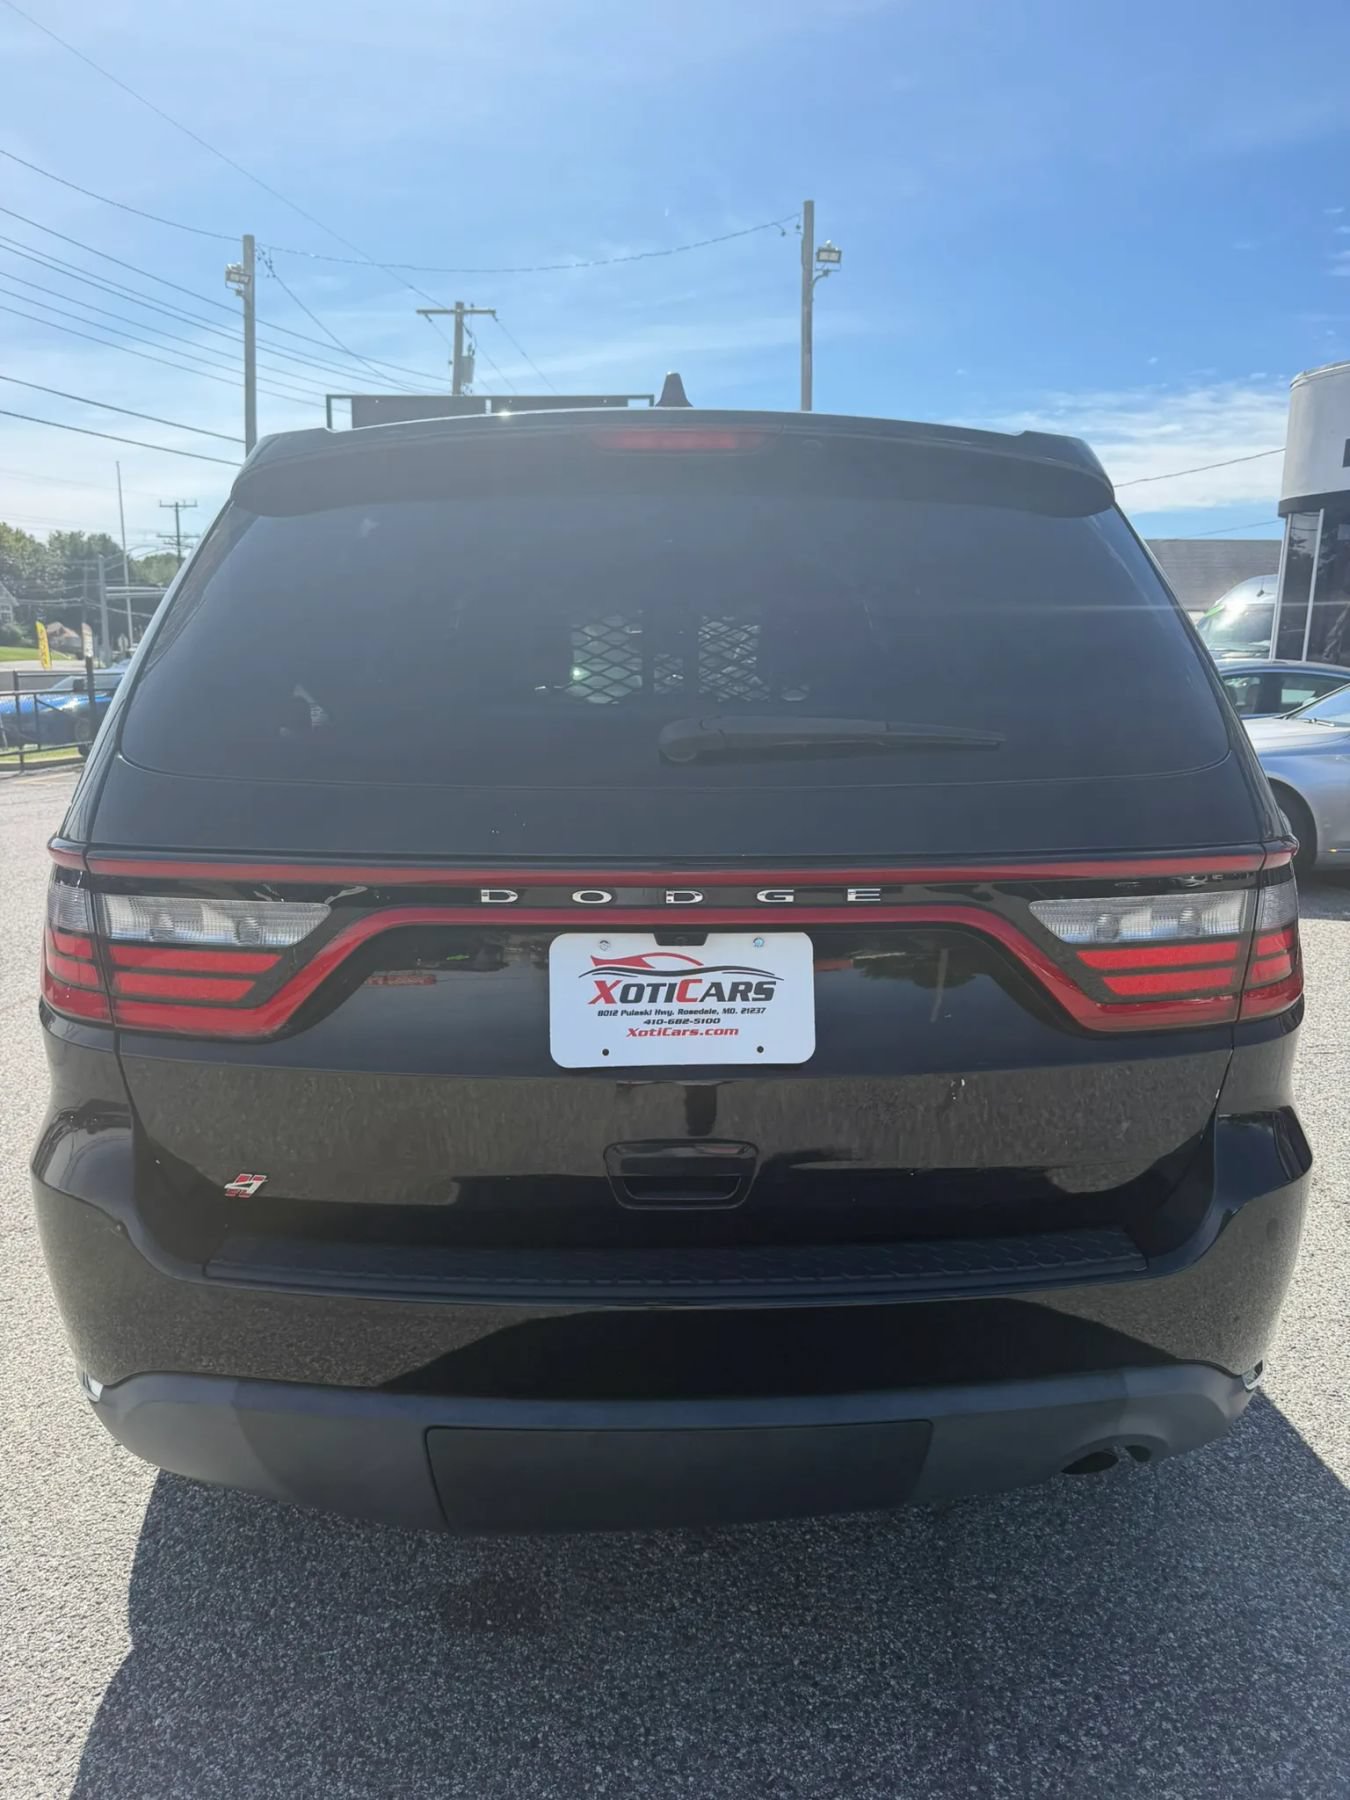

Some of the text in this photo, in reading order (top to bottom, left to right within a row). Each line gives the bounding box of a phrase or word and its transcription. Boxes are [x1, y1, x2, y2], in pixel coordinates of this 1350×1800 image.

[480, 887, 882, 904] DODGE
[597, 1009, 619, 1017] 8012
[620, 1009, 652, 1017] Pulaski
[654, 1008, 674, 1017] Hwy.
[677, 1008, 720, 1016] Rosedale,
[722, 1007, 738, 1015] MD.
[626, 1027, 739, 1038] XotiCars.com
